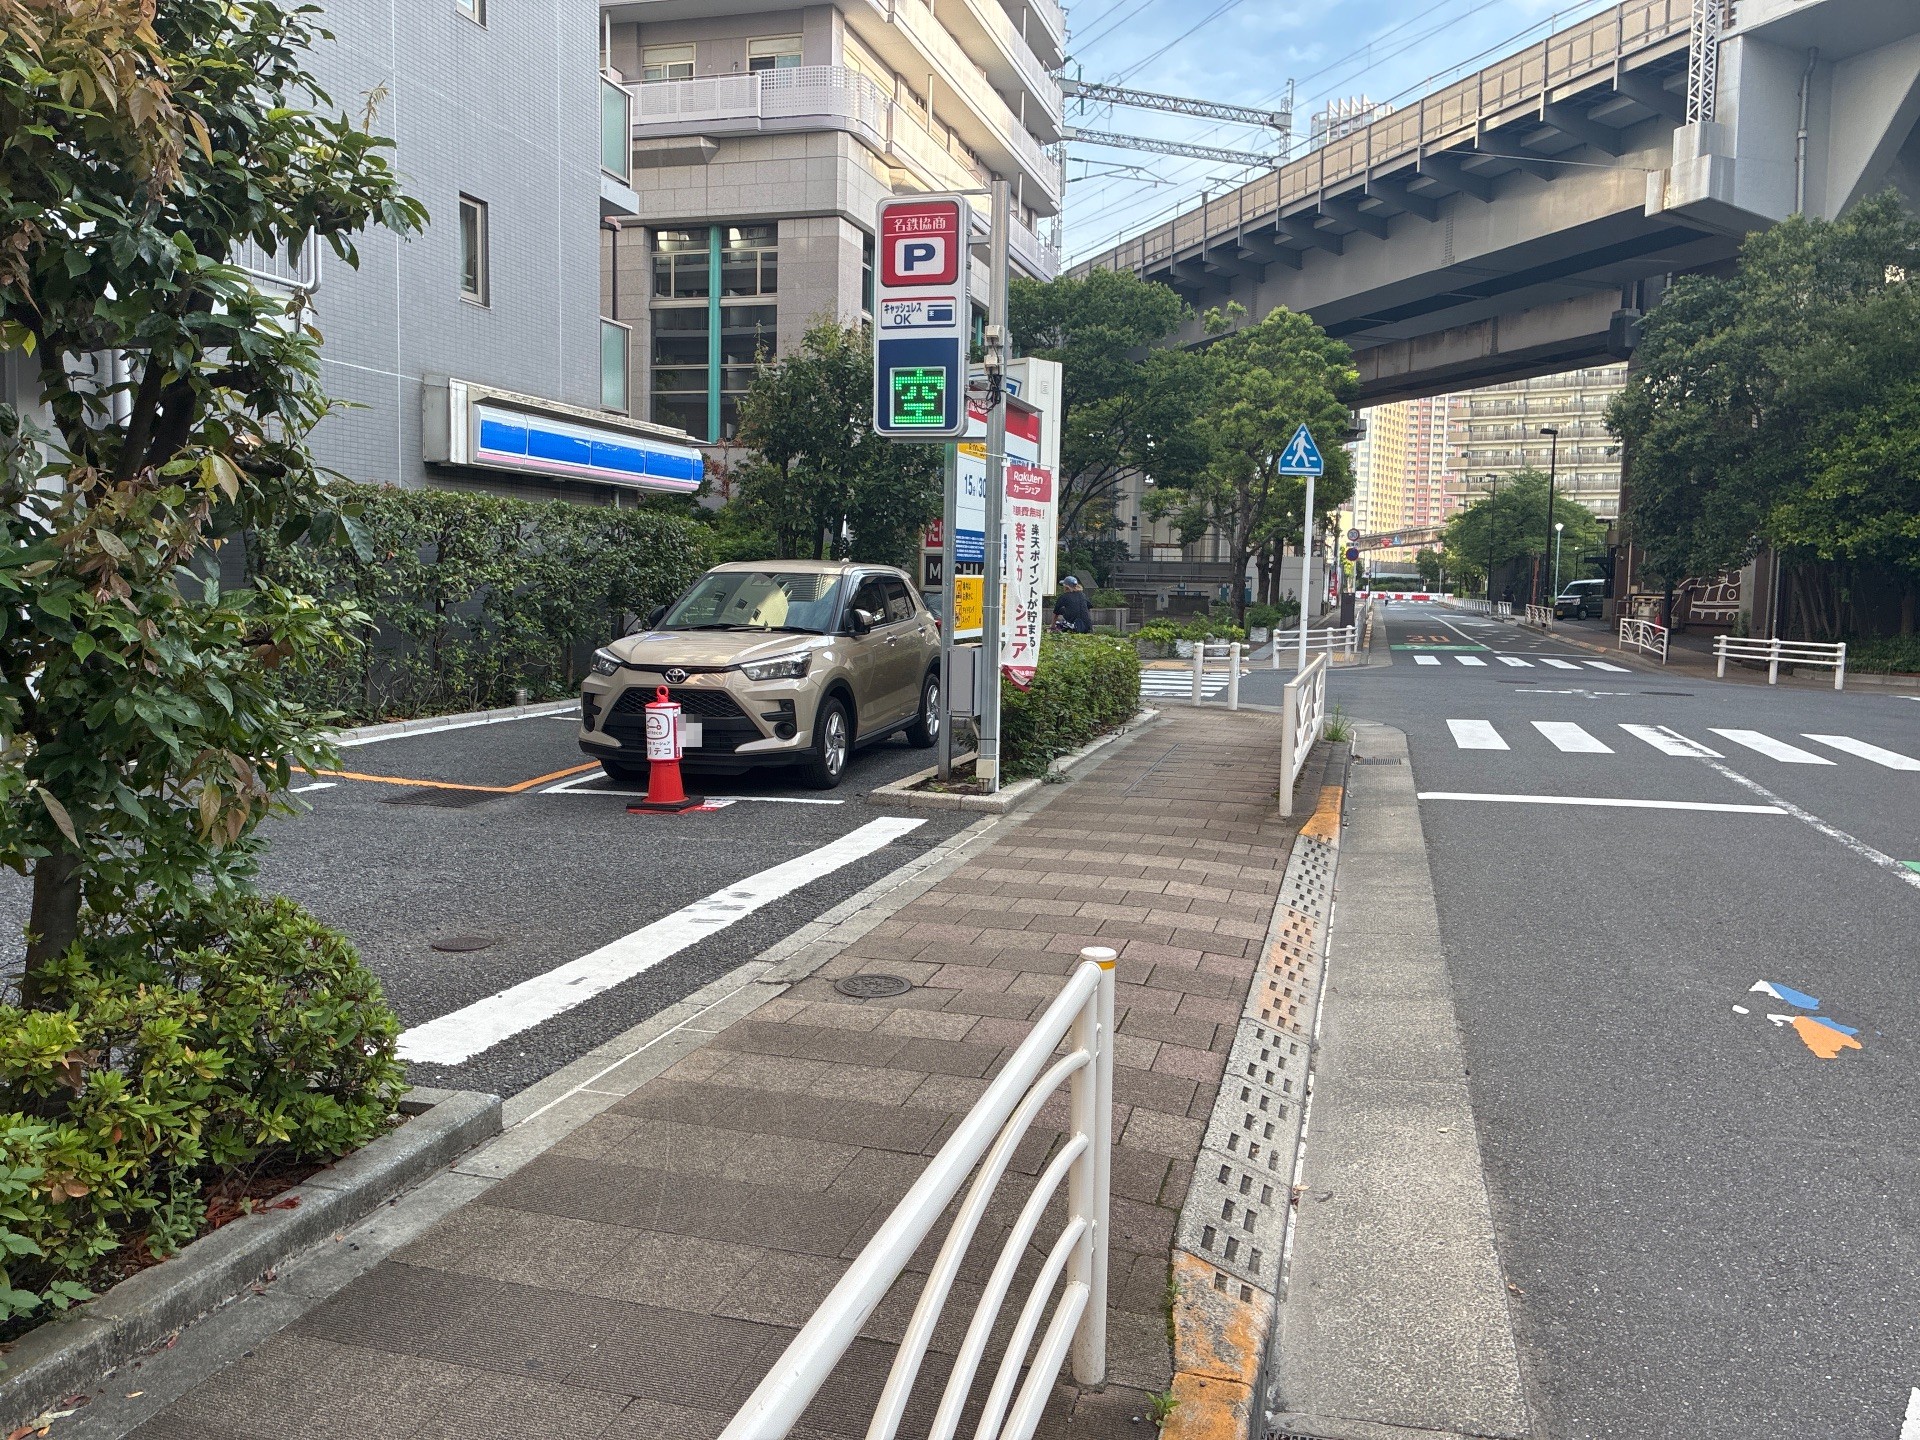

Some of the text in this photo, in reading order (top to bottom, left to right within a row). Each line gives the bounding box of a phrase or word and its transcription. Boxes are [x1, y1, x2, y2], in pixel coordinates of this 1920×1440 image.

[894, 216, 946, 232] 名鉄協商
[903, 243, 936, 271] P
[883, 303, 922, 315] キャッシュレス
[894, 314, 912, 325] OK
[895, 368, 944, 423] 空
[1013, 471, 1044, 484] Rakuten
[1013, 484, 1041, 495] カーシェア
[1011, 522, 1028, 659] 楽天カシェア
